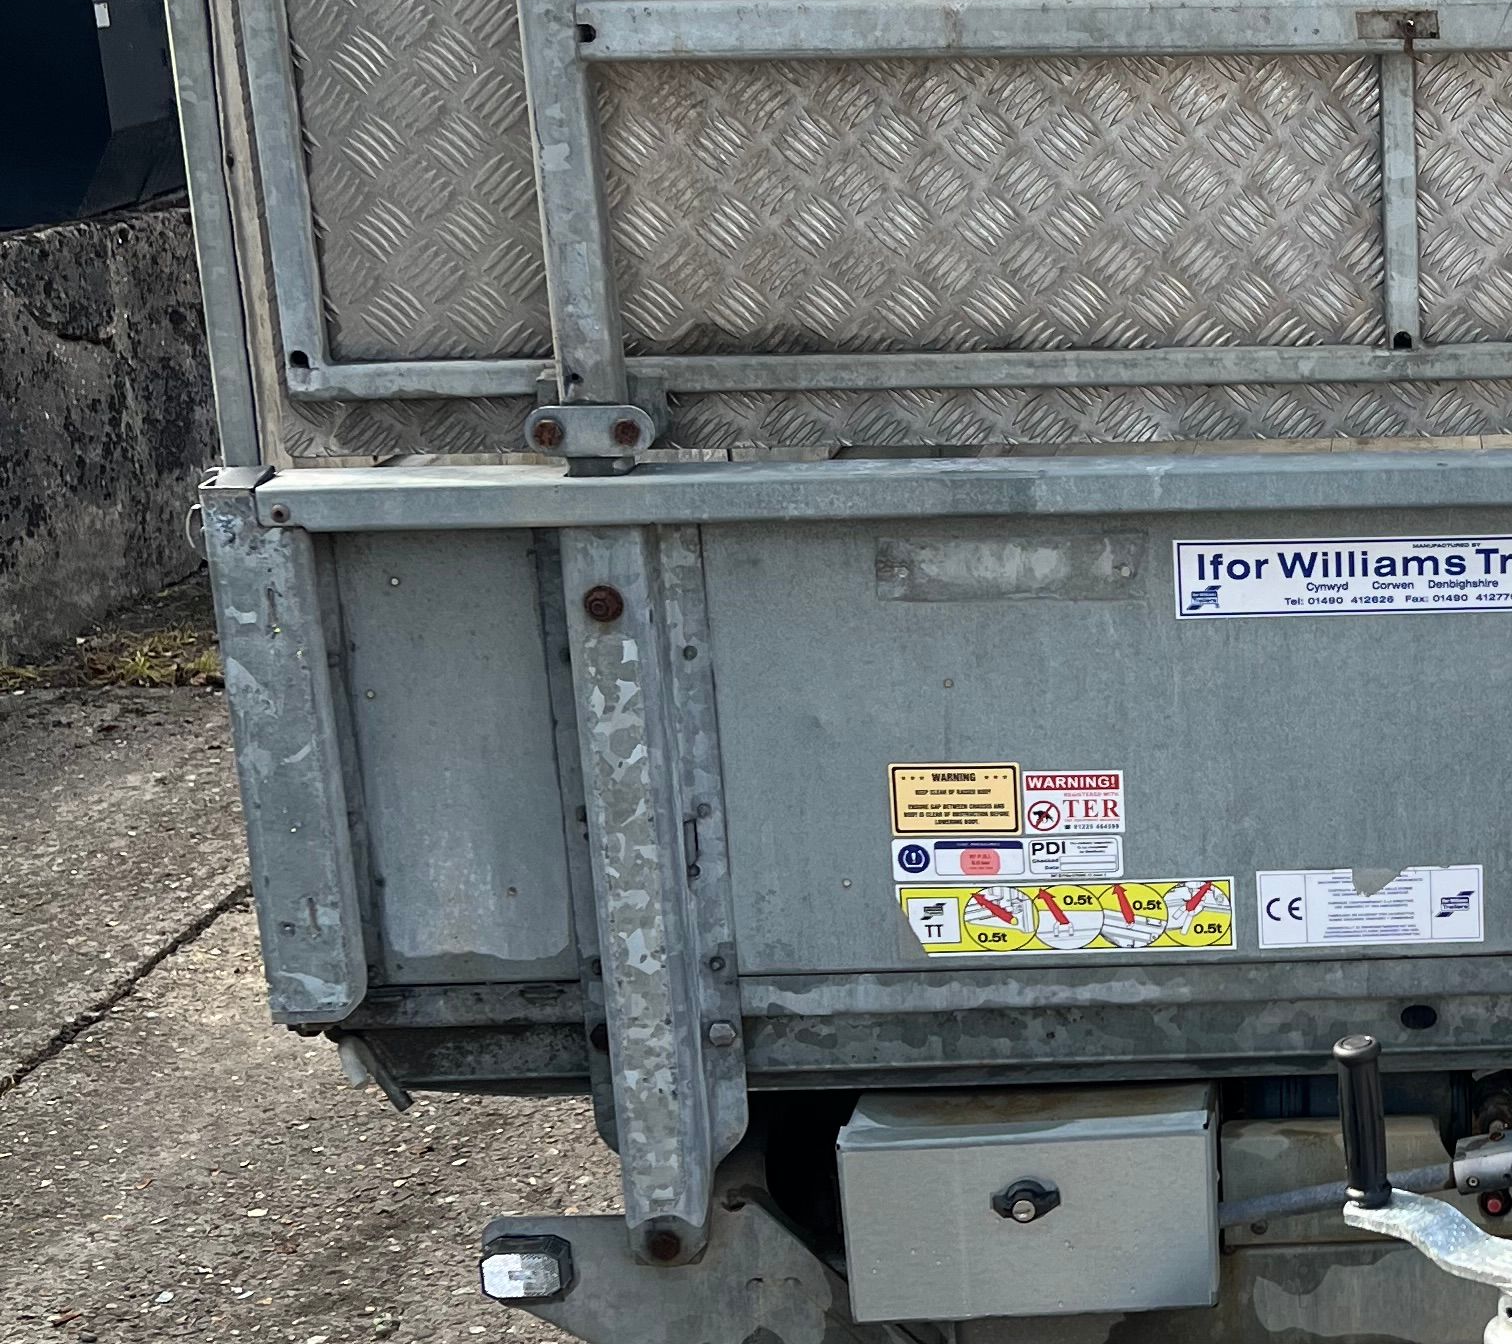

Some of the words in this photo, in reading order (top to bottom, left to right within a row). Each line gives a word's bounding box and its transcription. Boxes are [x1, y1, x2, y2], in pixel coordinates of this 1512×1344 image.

[1197, 553, 1269, 580] Ifor
[1277, 550, 1467, 579] Williams
[1306, 581, 1349, 593] Cynwyd
[1372, 580, 1414, 590] Corwen
[1428, 578, 1499, 590] Denbighshire
[1284, 597, 1304, 605] Tel:
[1405, 594, 1428, 603] Fax:
[931, 772, 976, 782] WARNING
[1027, 775, 1116, 789] WARNING!
[1062, 798, 1121, 818] TER
[1031, 840, 1066, 856] PDI
[1063, 895, 1094, 906] 0.5t
[1132, 900, 1162, 911] 0.5t
[1266, 896, 1303, 921] CE
[924, 924, 944, 937] TT
[1193, 923, 1223, 934] 0.5t
[977, 932, 1008, 943] 0.5t
